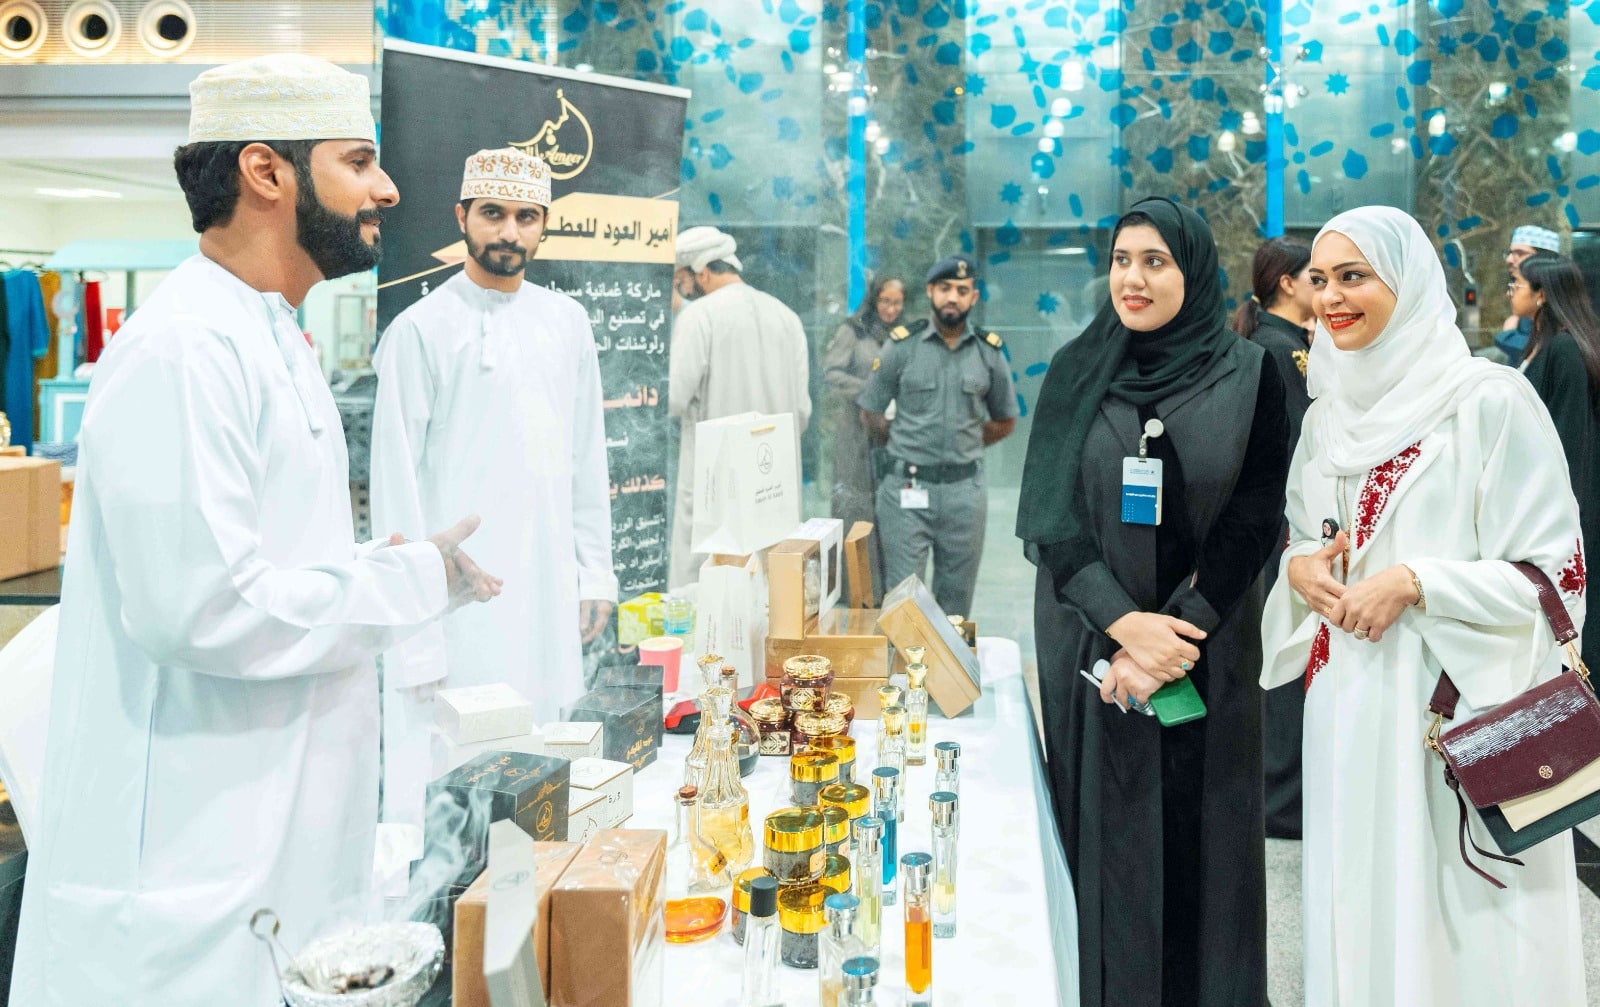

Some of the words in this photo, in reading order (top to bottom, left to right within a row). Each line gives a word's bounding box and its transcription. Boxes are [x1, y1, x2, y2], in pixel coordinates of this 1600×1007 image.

[540, 215, 598, 243] للعطو
[603, 220, 641, 246] العود
[645, 217, 673, 248] أمير
[626, 281, 662, 303] ماركة
[608, 310, 646, 331] تصنيع
[649, 309, 665, 331] في
[602, 384, 658, 408] دائم
[620, 473, 665, 494] كذلك
